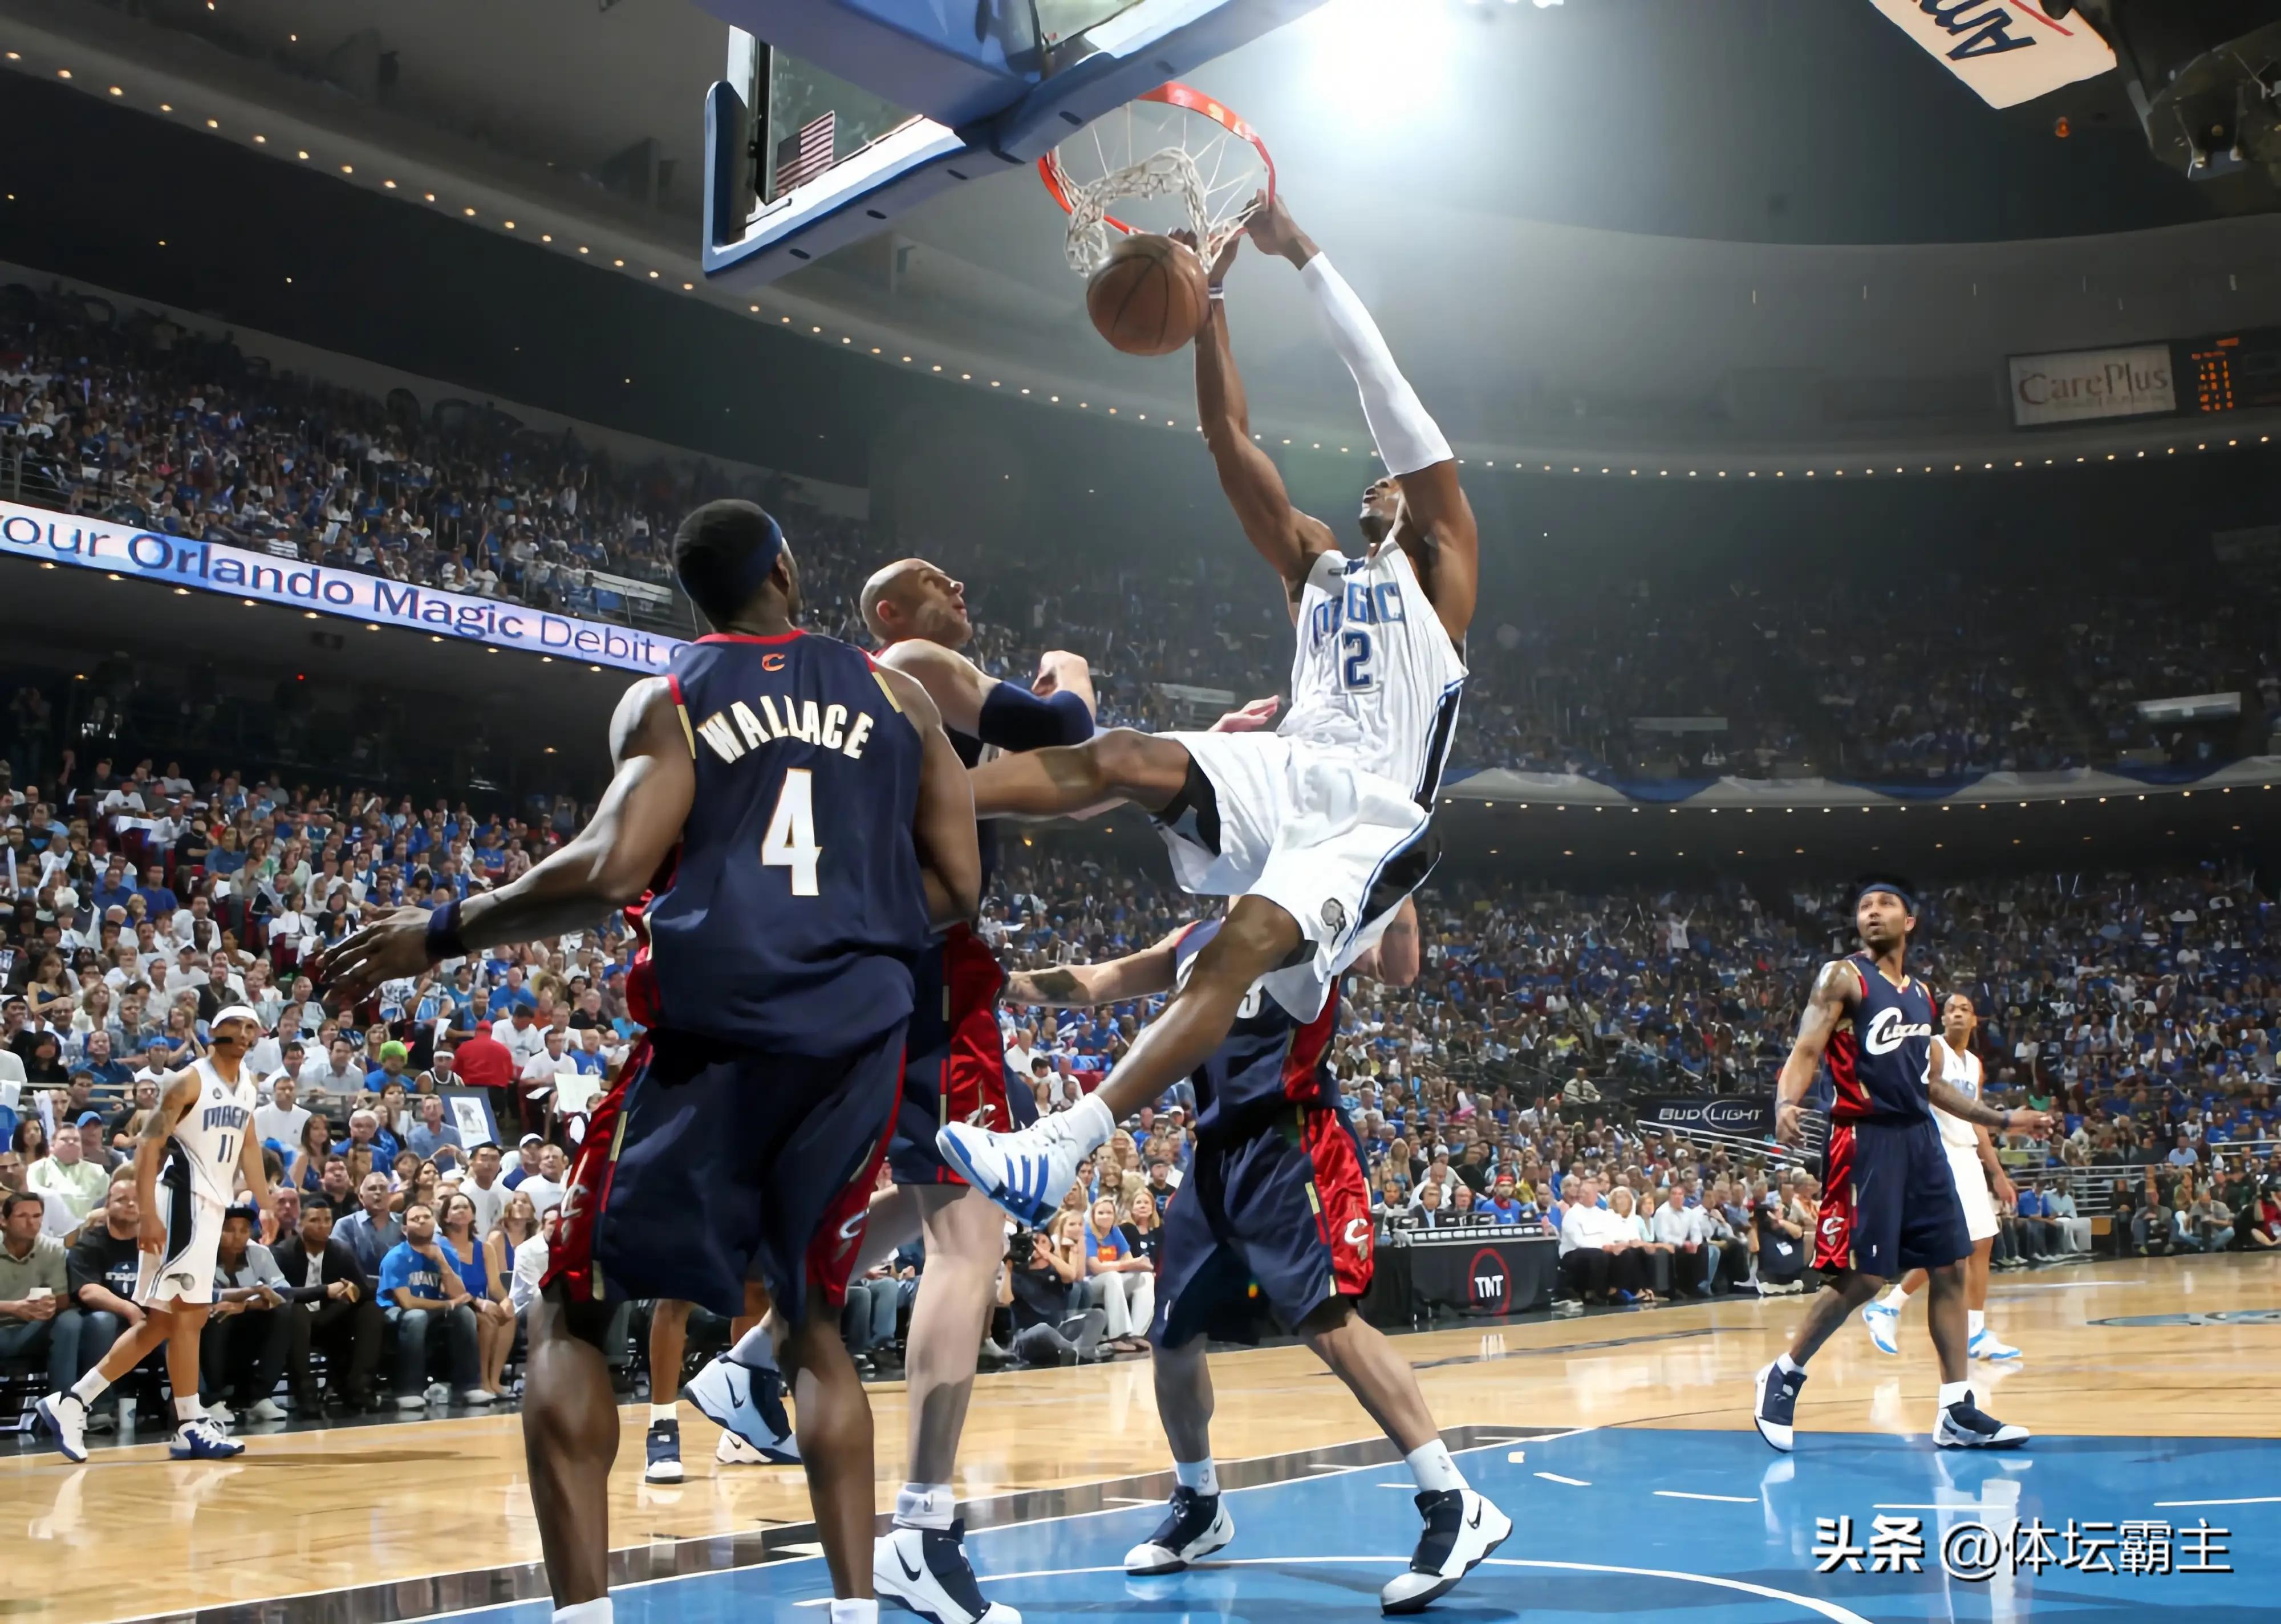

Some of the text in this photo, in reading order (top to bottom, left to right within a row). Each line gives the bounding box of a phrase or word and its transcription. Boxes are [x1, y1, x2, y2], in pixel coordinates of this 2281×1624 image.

[2019, 362, 2168, 405] CarePlus
[0, 513, 656, 666] our Orlando Magic Debit
[696, 695, 874, 764] WALLACE
[761, 768, 823, 896] 4
[1658, 1108, 1763, 1120] BUD LIGHT
[218, 1134, 234, 1163] 11
[1475, 1275, 1504, 1298] TNT
